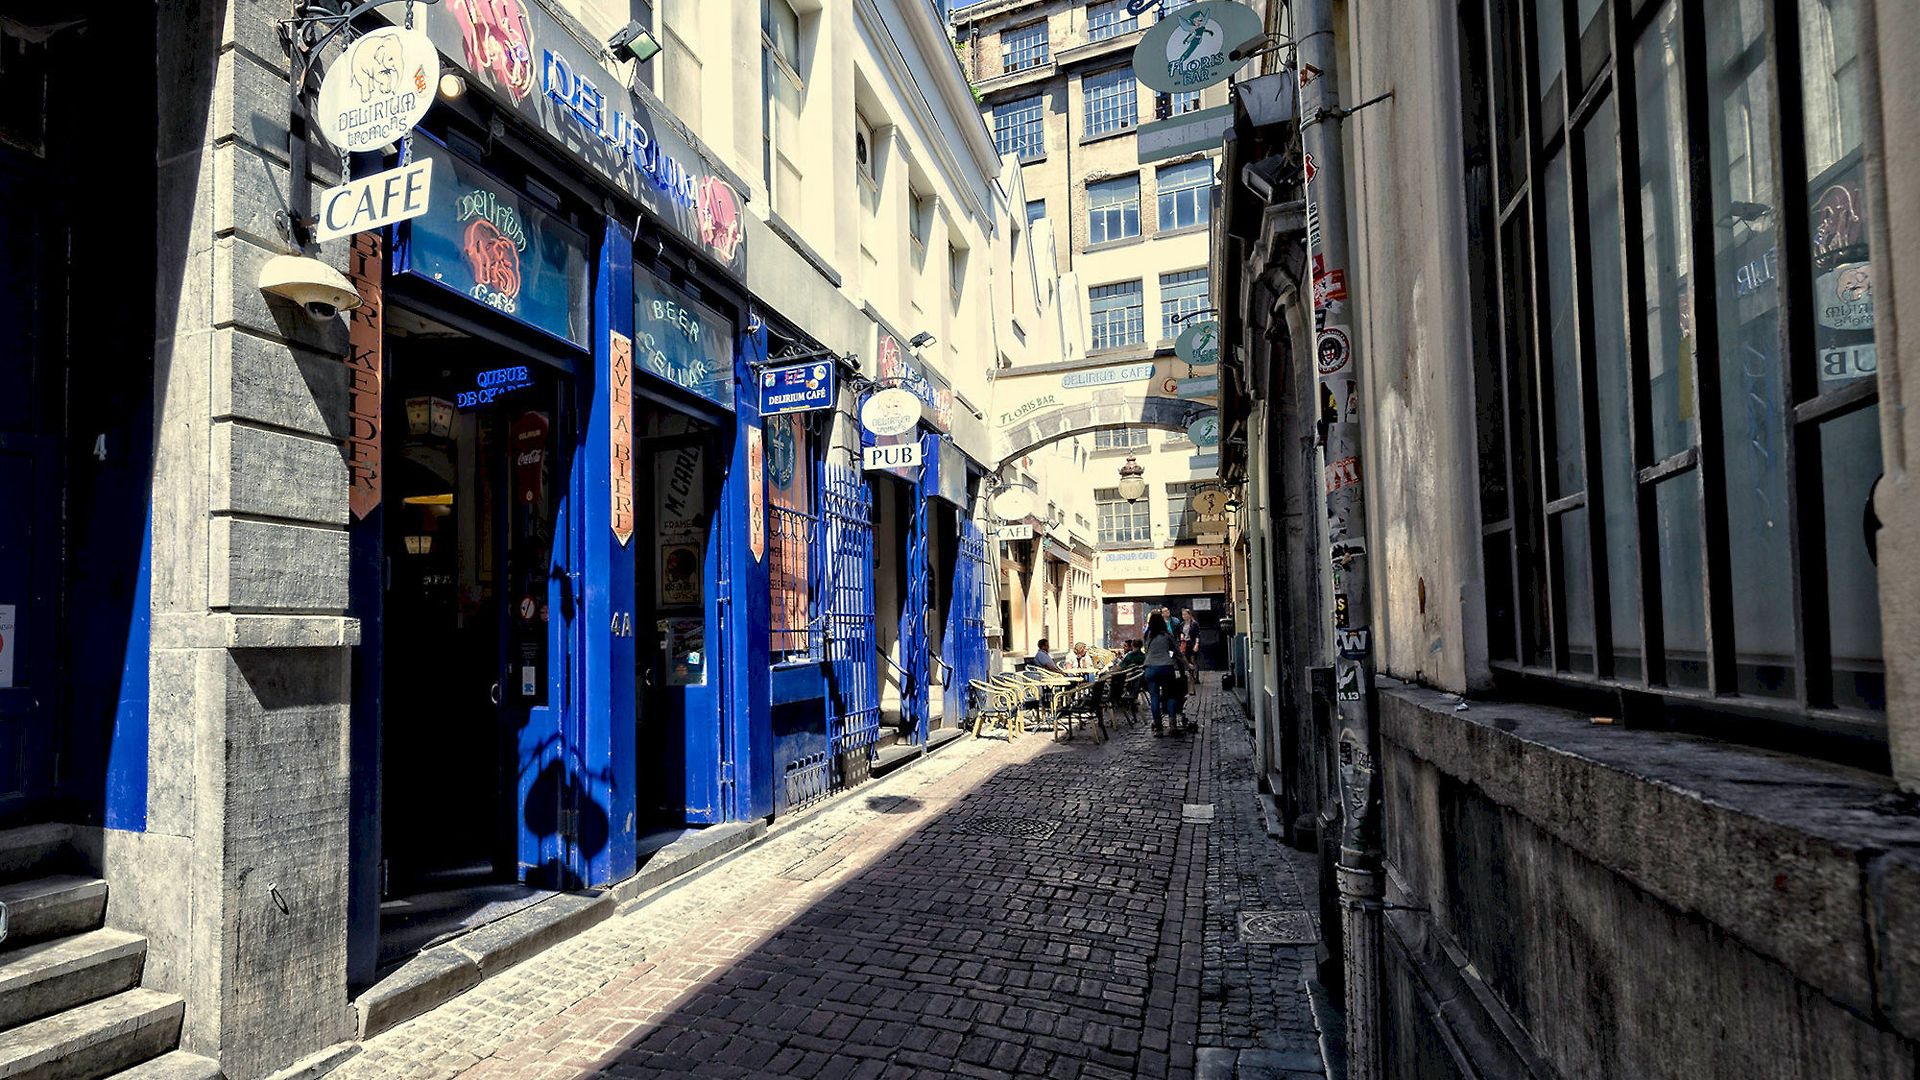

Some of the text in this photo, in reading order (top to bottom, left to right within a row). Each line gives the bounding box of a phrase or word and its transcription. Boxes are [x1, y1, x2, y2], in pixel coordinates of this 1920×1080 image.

[1168, 51, 1225, 78] FLORIS
[1183, 69, 1210, 86] BAR
[338, 92, 417, 132] DELIRIUM
[543, 48, 698, 210] DELIRIUM
[326, 168, 425, 232] CAFE
[653, 299, 700, 342] BEER
[613, 337, 631, 406] CAVE
[644, 332, 708, 388] CELLAR
[477, 365, 528, 387] QUEUE
[1063, 370, 1117, 387] DELIRIUM
[768, 387, 827, 406] DELIRIUM CAFÉ
[1000, 394, 1056, 425] FLORIS BAR
[348, 344, 378, 492] KELDER
[93, 433, 107, 461] 4
[872, 446, 912, 466] PUB
[996, 527, 1029, 539] CAFE
[1165, 554, 1226, 572] GARDEN
[611, 611, 633, 638] 4A
